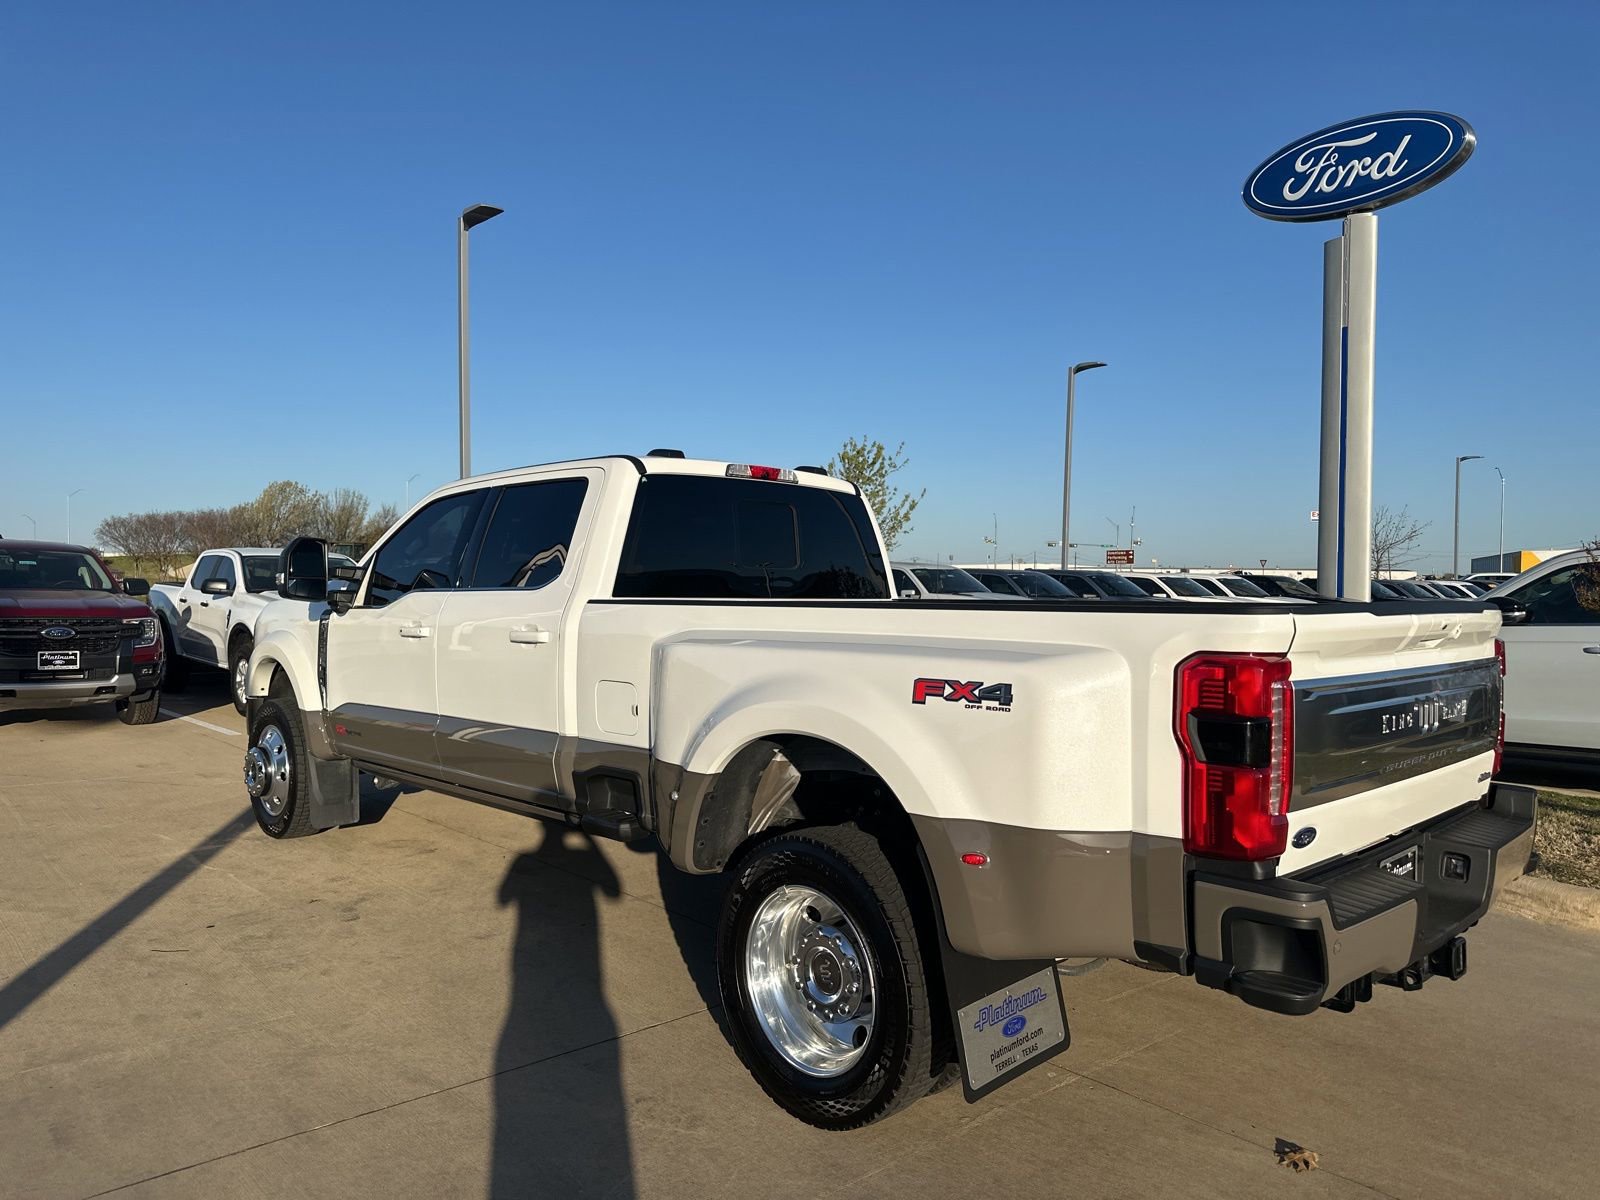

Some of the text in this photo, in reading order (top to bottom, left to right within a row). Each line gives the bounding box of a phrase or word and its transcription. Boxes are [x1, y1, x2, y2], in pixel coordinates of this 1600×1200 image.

[1283, 132, 1412, 201] Ford
[912, 678, 1013, 706] FX4
[1382, 710, 1413, 734] KING
[974, 987, 1047, 1032] Platinum
[1006, 1018, 1024, 1035] Ford
[990, 1027, 1044, 1064] platinumford.com
[995, 1043, 1039, 1073] TERRELL TEXAS
